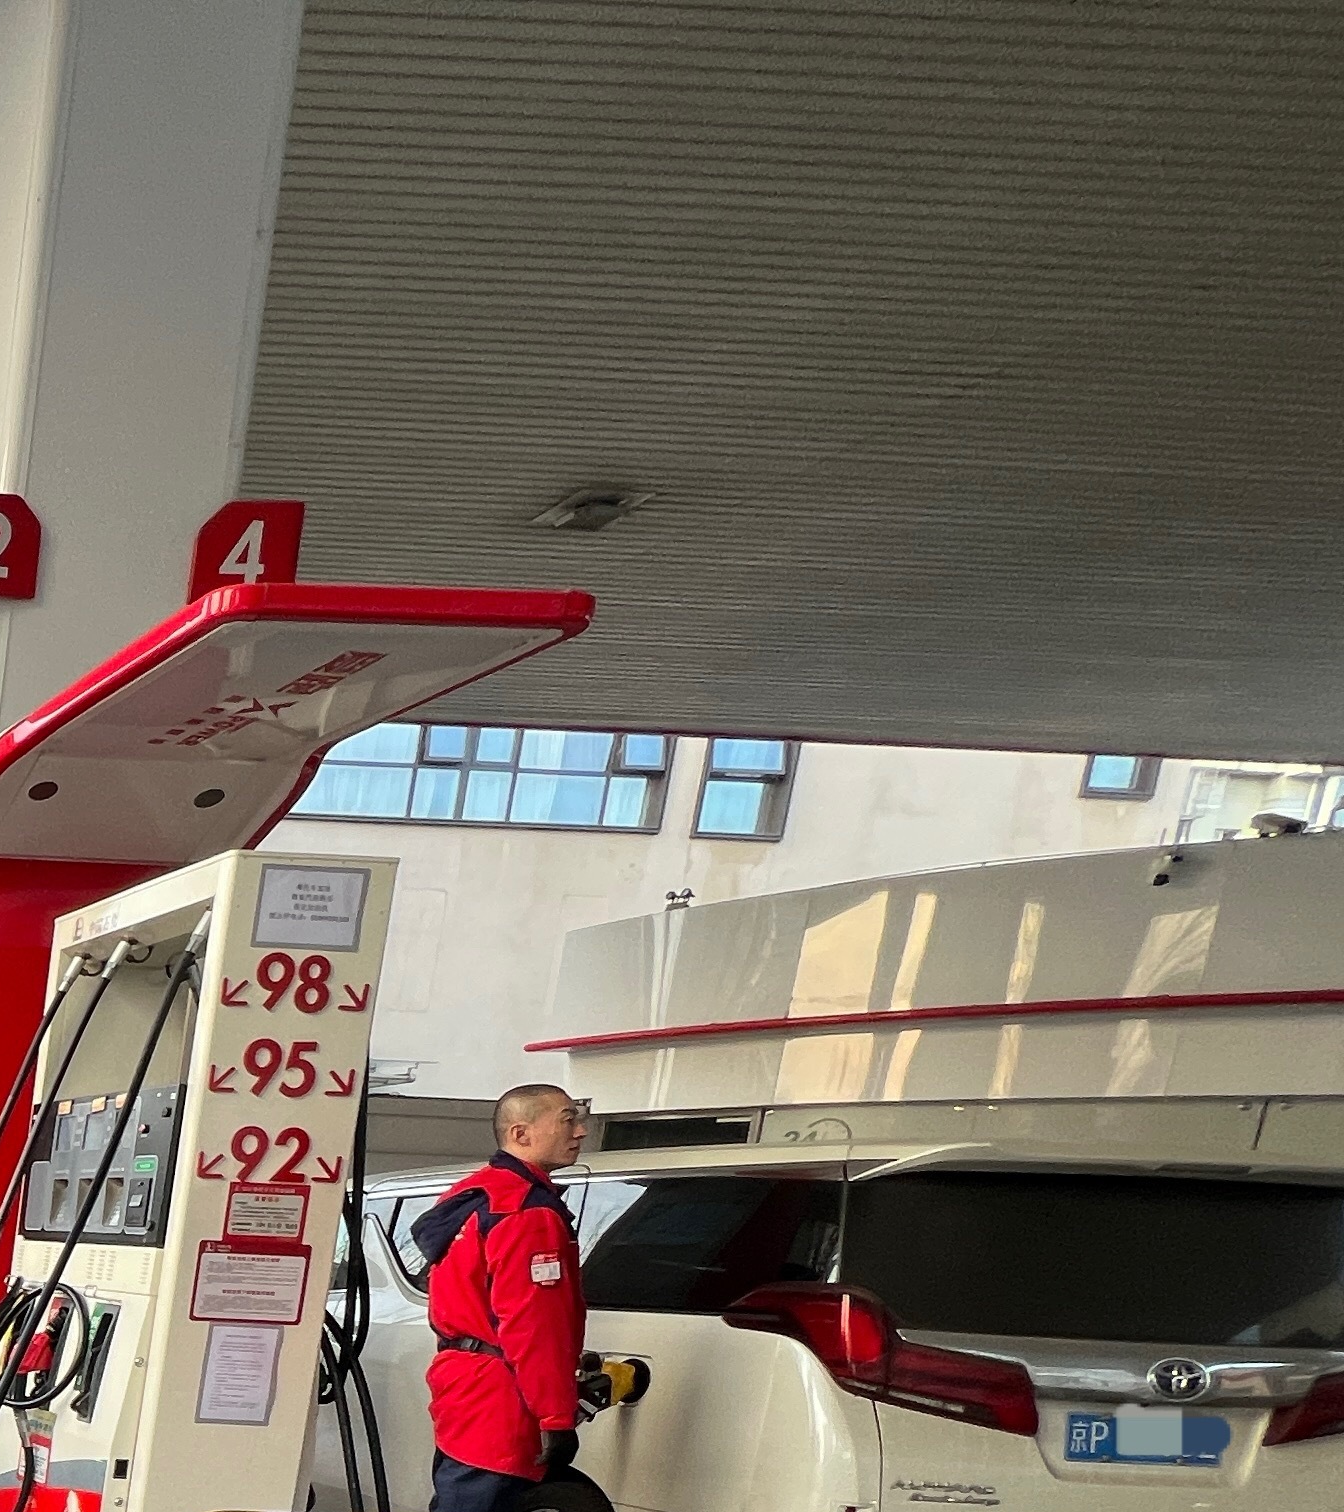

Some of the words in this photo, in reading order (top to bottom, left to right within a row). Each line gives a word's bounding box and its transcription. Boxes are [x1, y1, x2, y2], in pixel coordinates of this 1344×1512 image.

[218, 519, 265, 584] 4
[256, 952, 332, 1014] 98
[243, 1038, 318, 1099] 95
[230, 1126, 311, 1184] 92
